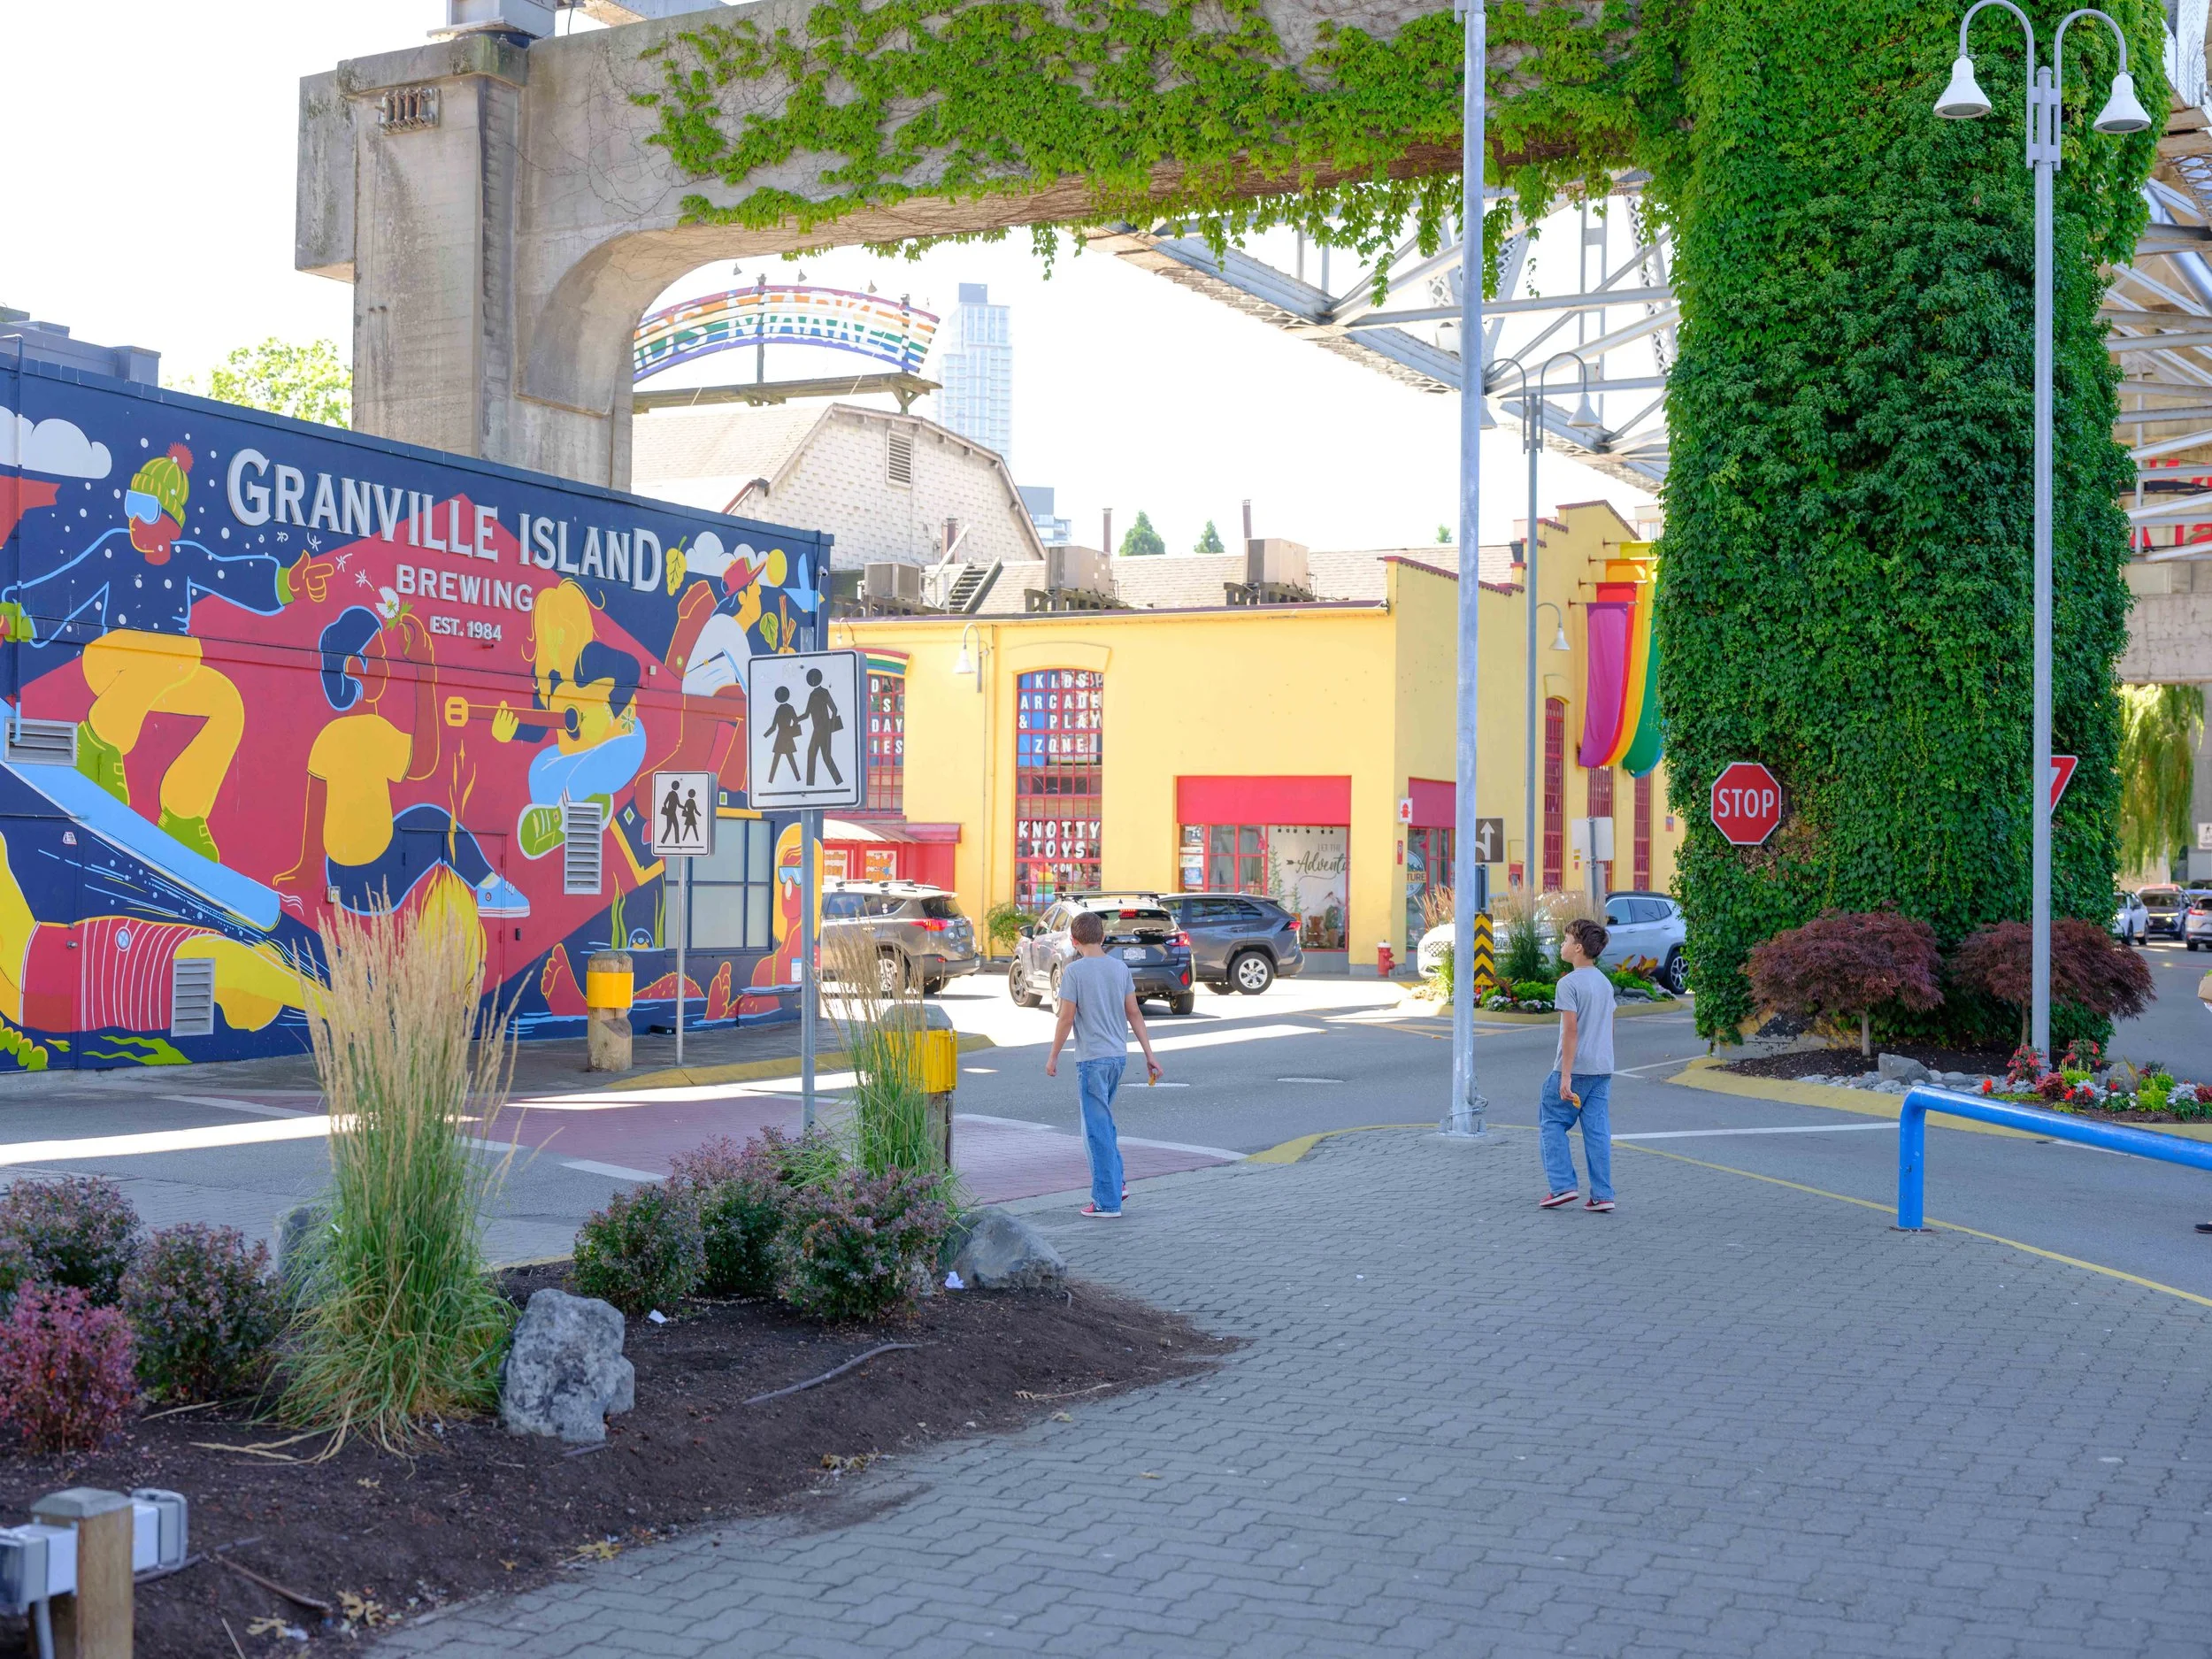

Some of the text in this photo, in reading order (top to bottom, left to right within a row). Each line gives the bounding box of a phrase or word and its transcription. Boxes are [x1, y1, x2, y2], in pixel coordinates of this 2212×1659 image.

[726, 289, 935, 362] MARKET
[227, 448, 663, 593] GRANVILLE ISLAND
[396, 564, 534, 612] BREWING
[429, 615, 503, 641] EST. 1984
[1035, 673, 1088, 689] KIDS
[1020, 695, 1102, 710] ARCADE
[1018, 714, 1102, 729] & PLAY
[1034, 738, 1085, 754] ZONE
[1717, 787, 1775, 818] STOP
[1018, 820, 1101, 839] KNOTTY
[1031, 840, 1086, 858] TOYS
